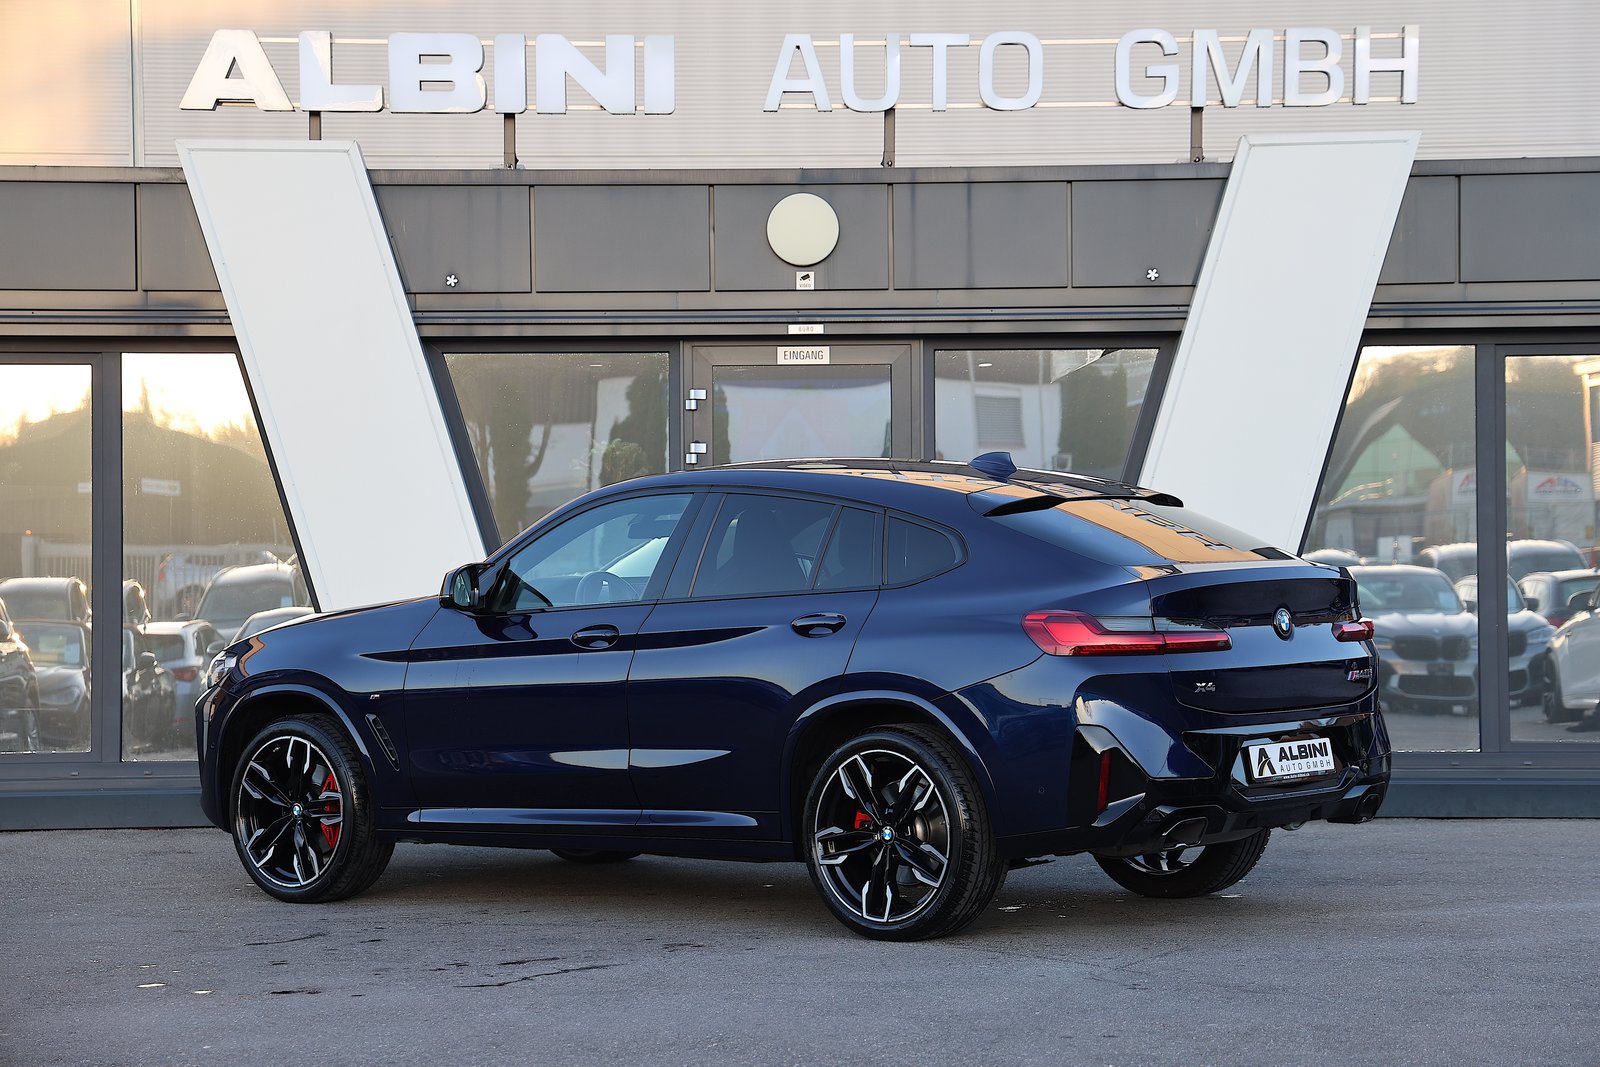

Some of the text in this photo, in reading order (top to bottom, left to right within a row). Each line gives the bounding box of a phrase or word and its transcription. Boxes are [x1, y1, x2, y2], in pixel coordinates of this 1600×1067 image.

[179, 25, 1420, 115] ALBINI AUTO GMBH
[783, 350, 824, 360] EINGANG
[1195, 682, 1216, 693] X4
[1278, 741, 1329, 763] ALBINI
[1280, 759, 1332, 773] AUTO GMBH
